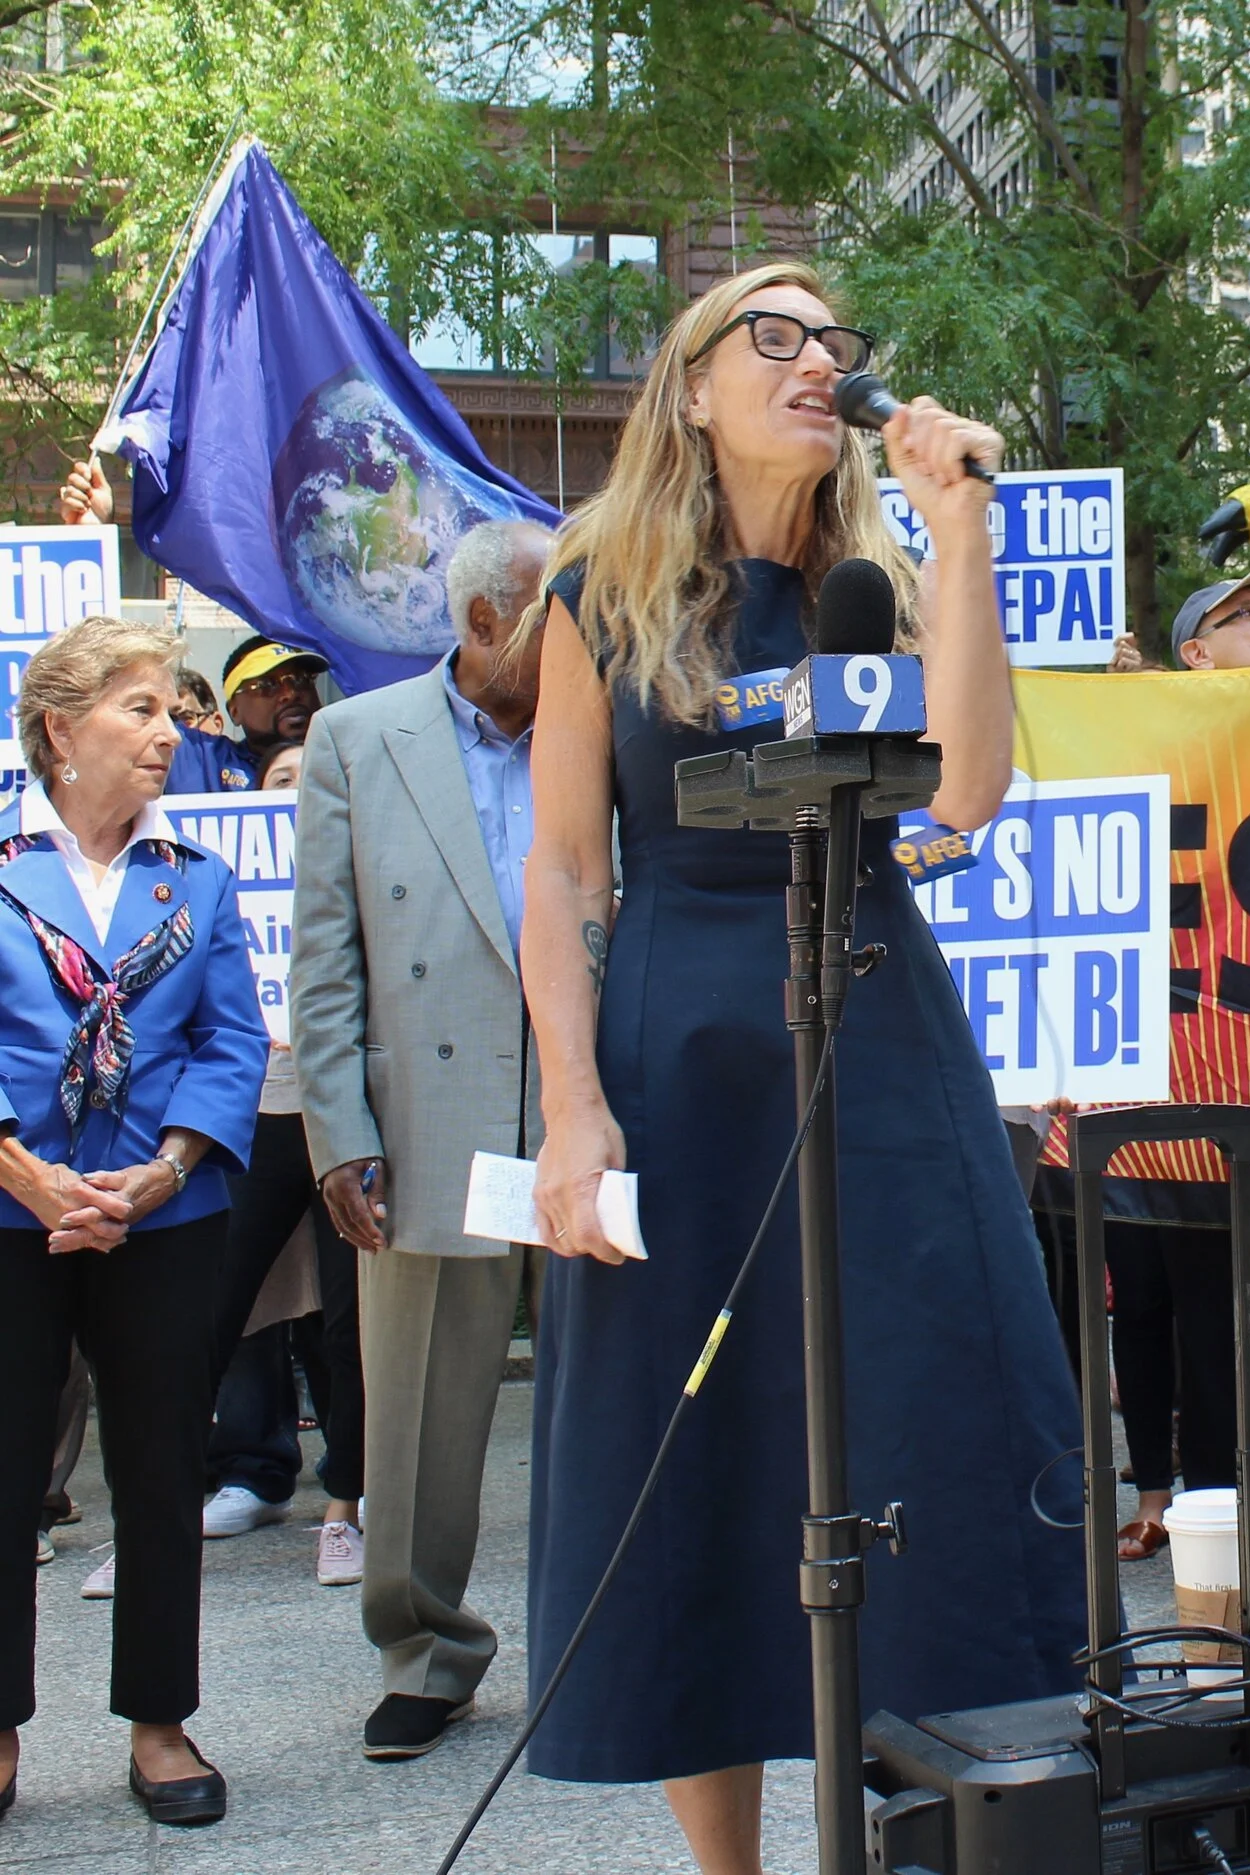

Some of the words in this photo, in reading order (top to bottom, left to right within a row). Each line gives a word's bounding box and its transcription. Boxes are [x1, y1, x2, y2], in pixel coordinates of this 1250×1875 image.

[881, 492, 1006, 560] Sae
[1021, 485, 1112, 556] the
[0, 546, 105, 634] the
[995, 566, 1113, 643] EPA!
[784, 672, 810, 723] WGN
[843, 655, 892, 731] 9
[921, 833, 972, 867] AFGE
[1053, 811, 1140, 917] NO
[1074, 948, 1140, 1067] B!
[1194, 1583, 1213, 1591] That
[1215, 1582, 1233, 1591] first
